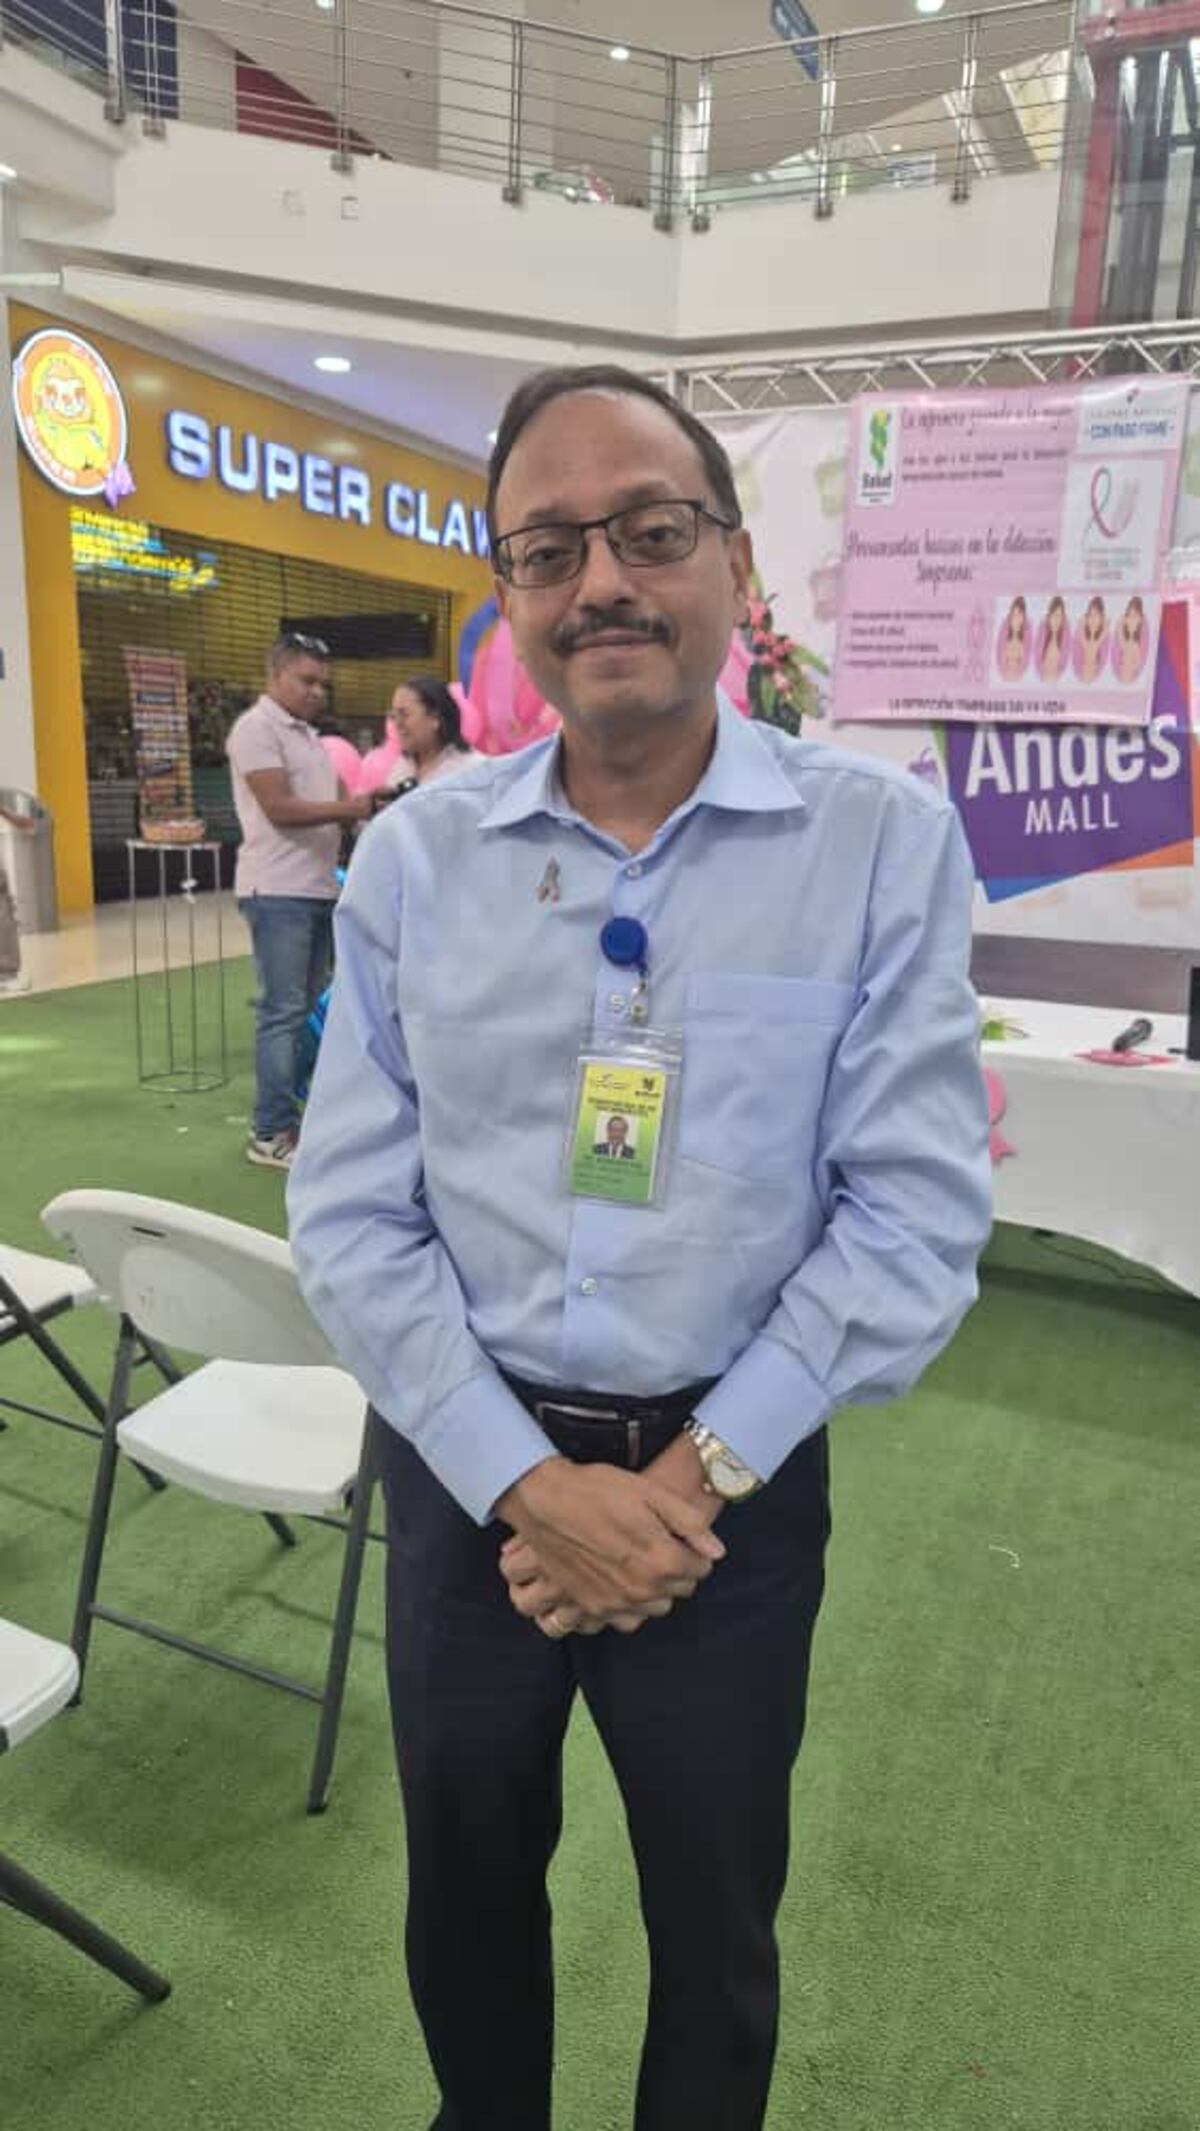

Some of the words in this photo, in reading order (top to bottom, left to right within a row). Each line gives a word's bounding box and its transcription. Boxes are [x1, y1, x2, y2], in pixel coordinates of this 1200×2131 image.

[166, 409, 370, 526] SUPER
[965, 714, 1181, 798] Andes
[1024, 792, 1119, 836] MALL
